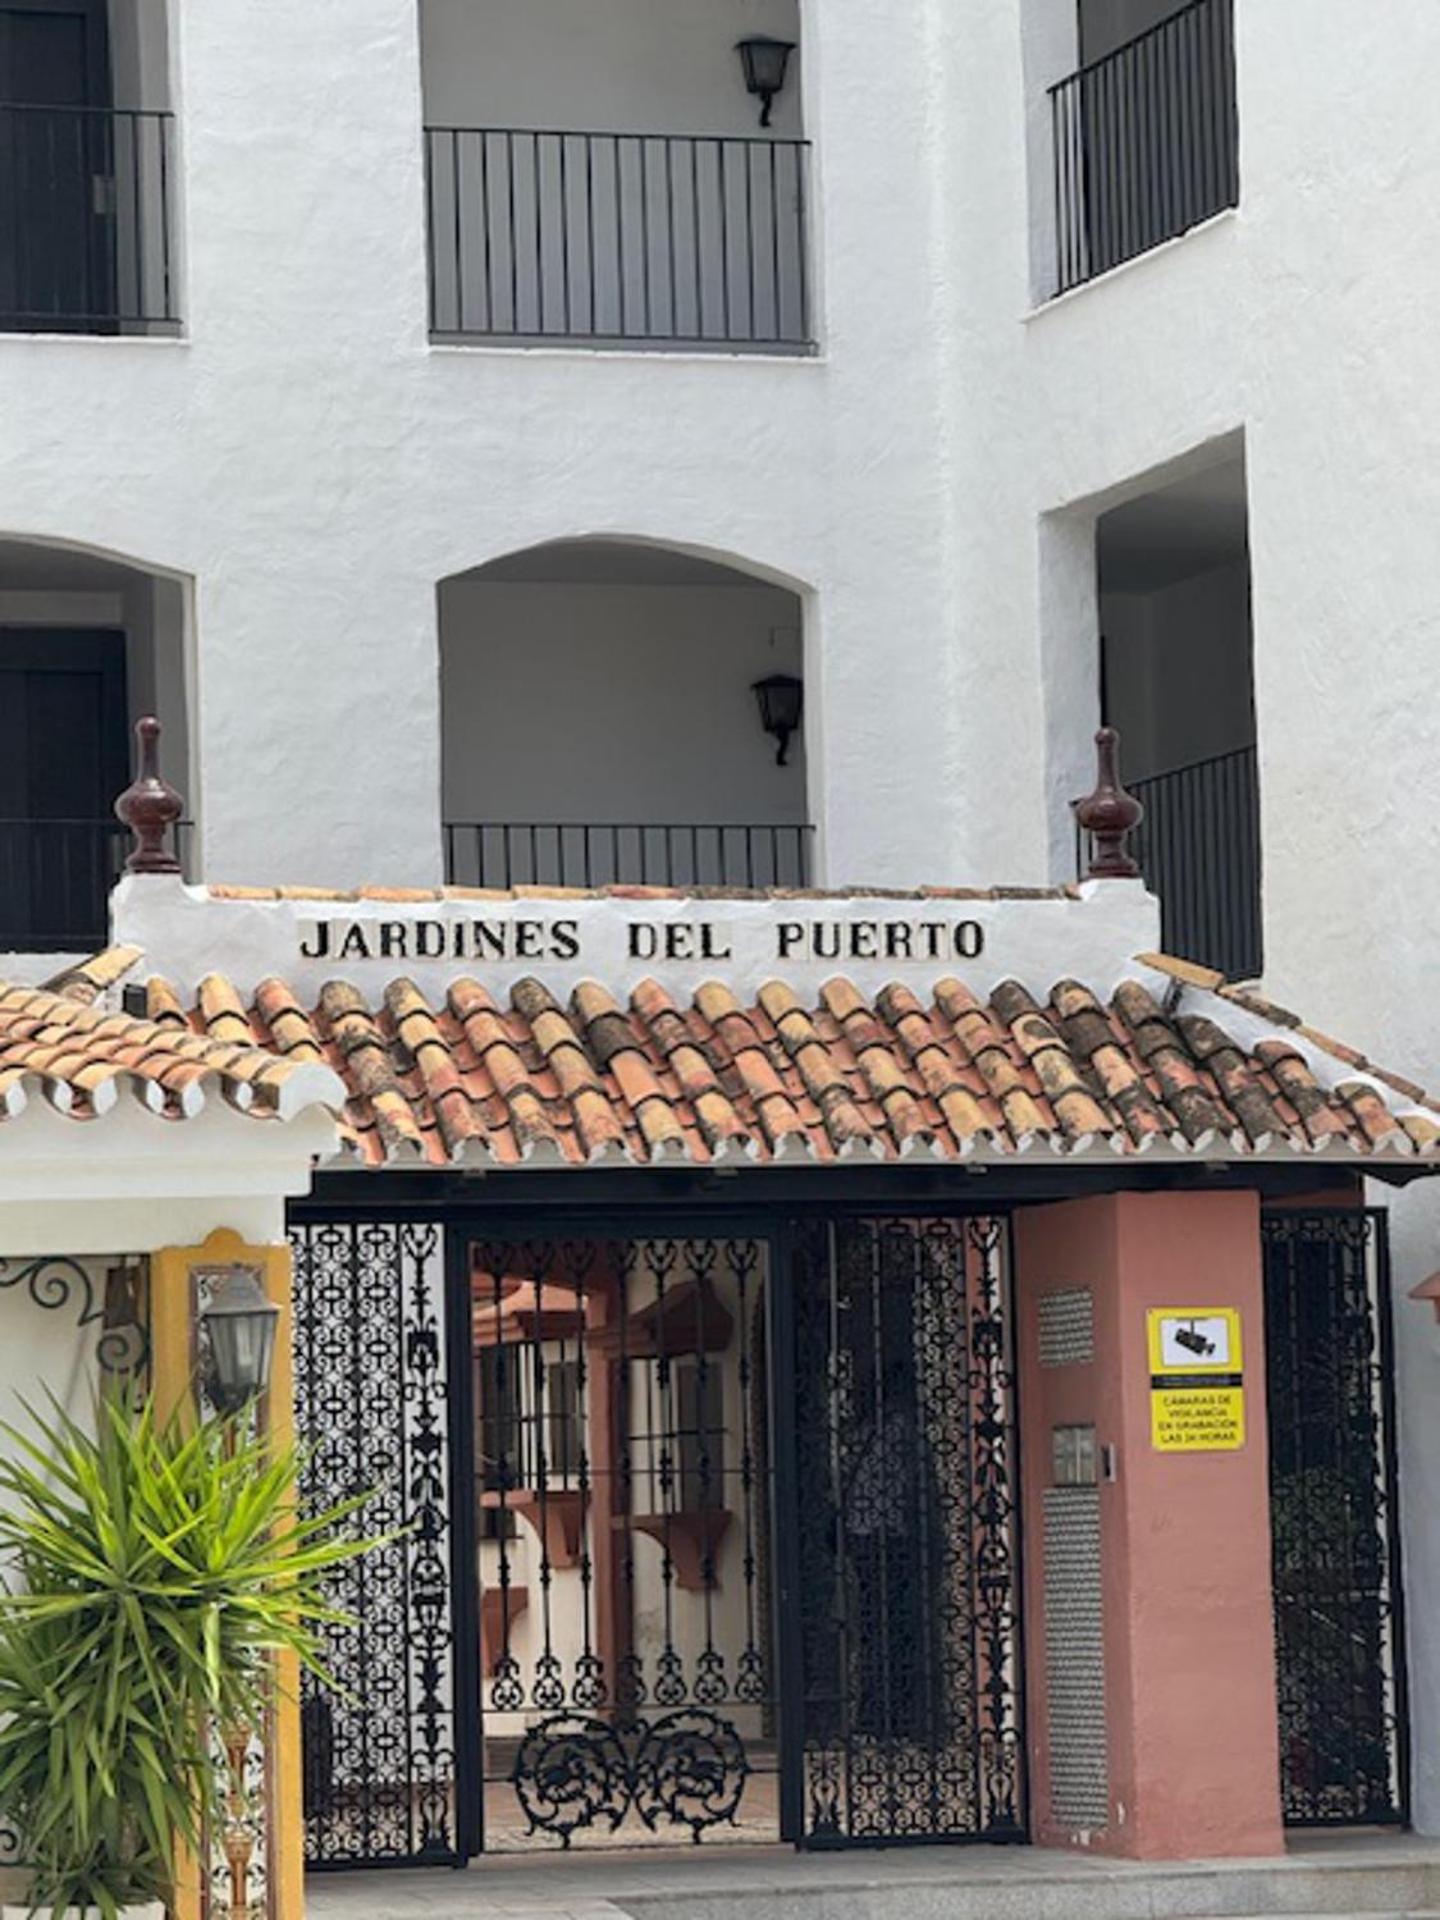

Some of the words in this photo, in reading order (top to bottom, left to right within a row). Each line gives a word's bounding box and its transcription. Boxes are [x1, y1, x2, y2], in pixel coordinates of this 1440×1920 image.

[301, 920, 579, 959] JARDINES
[628, 922, 731, 959] DEL
[778, 920, 985, 959] PUERTO
